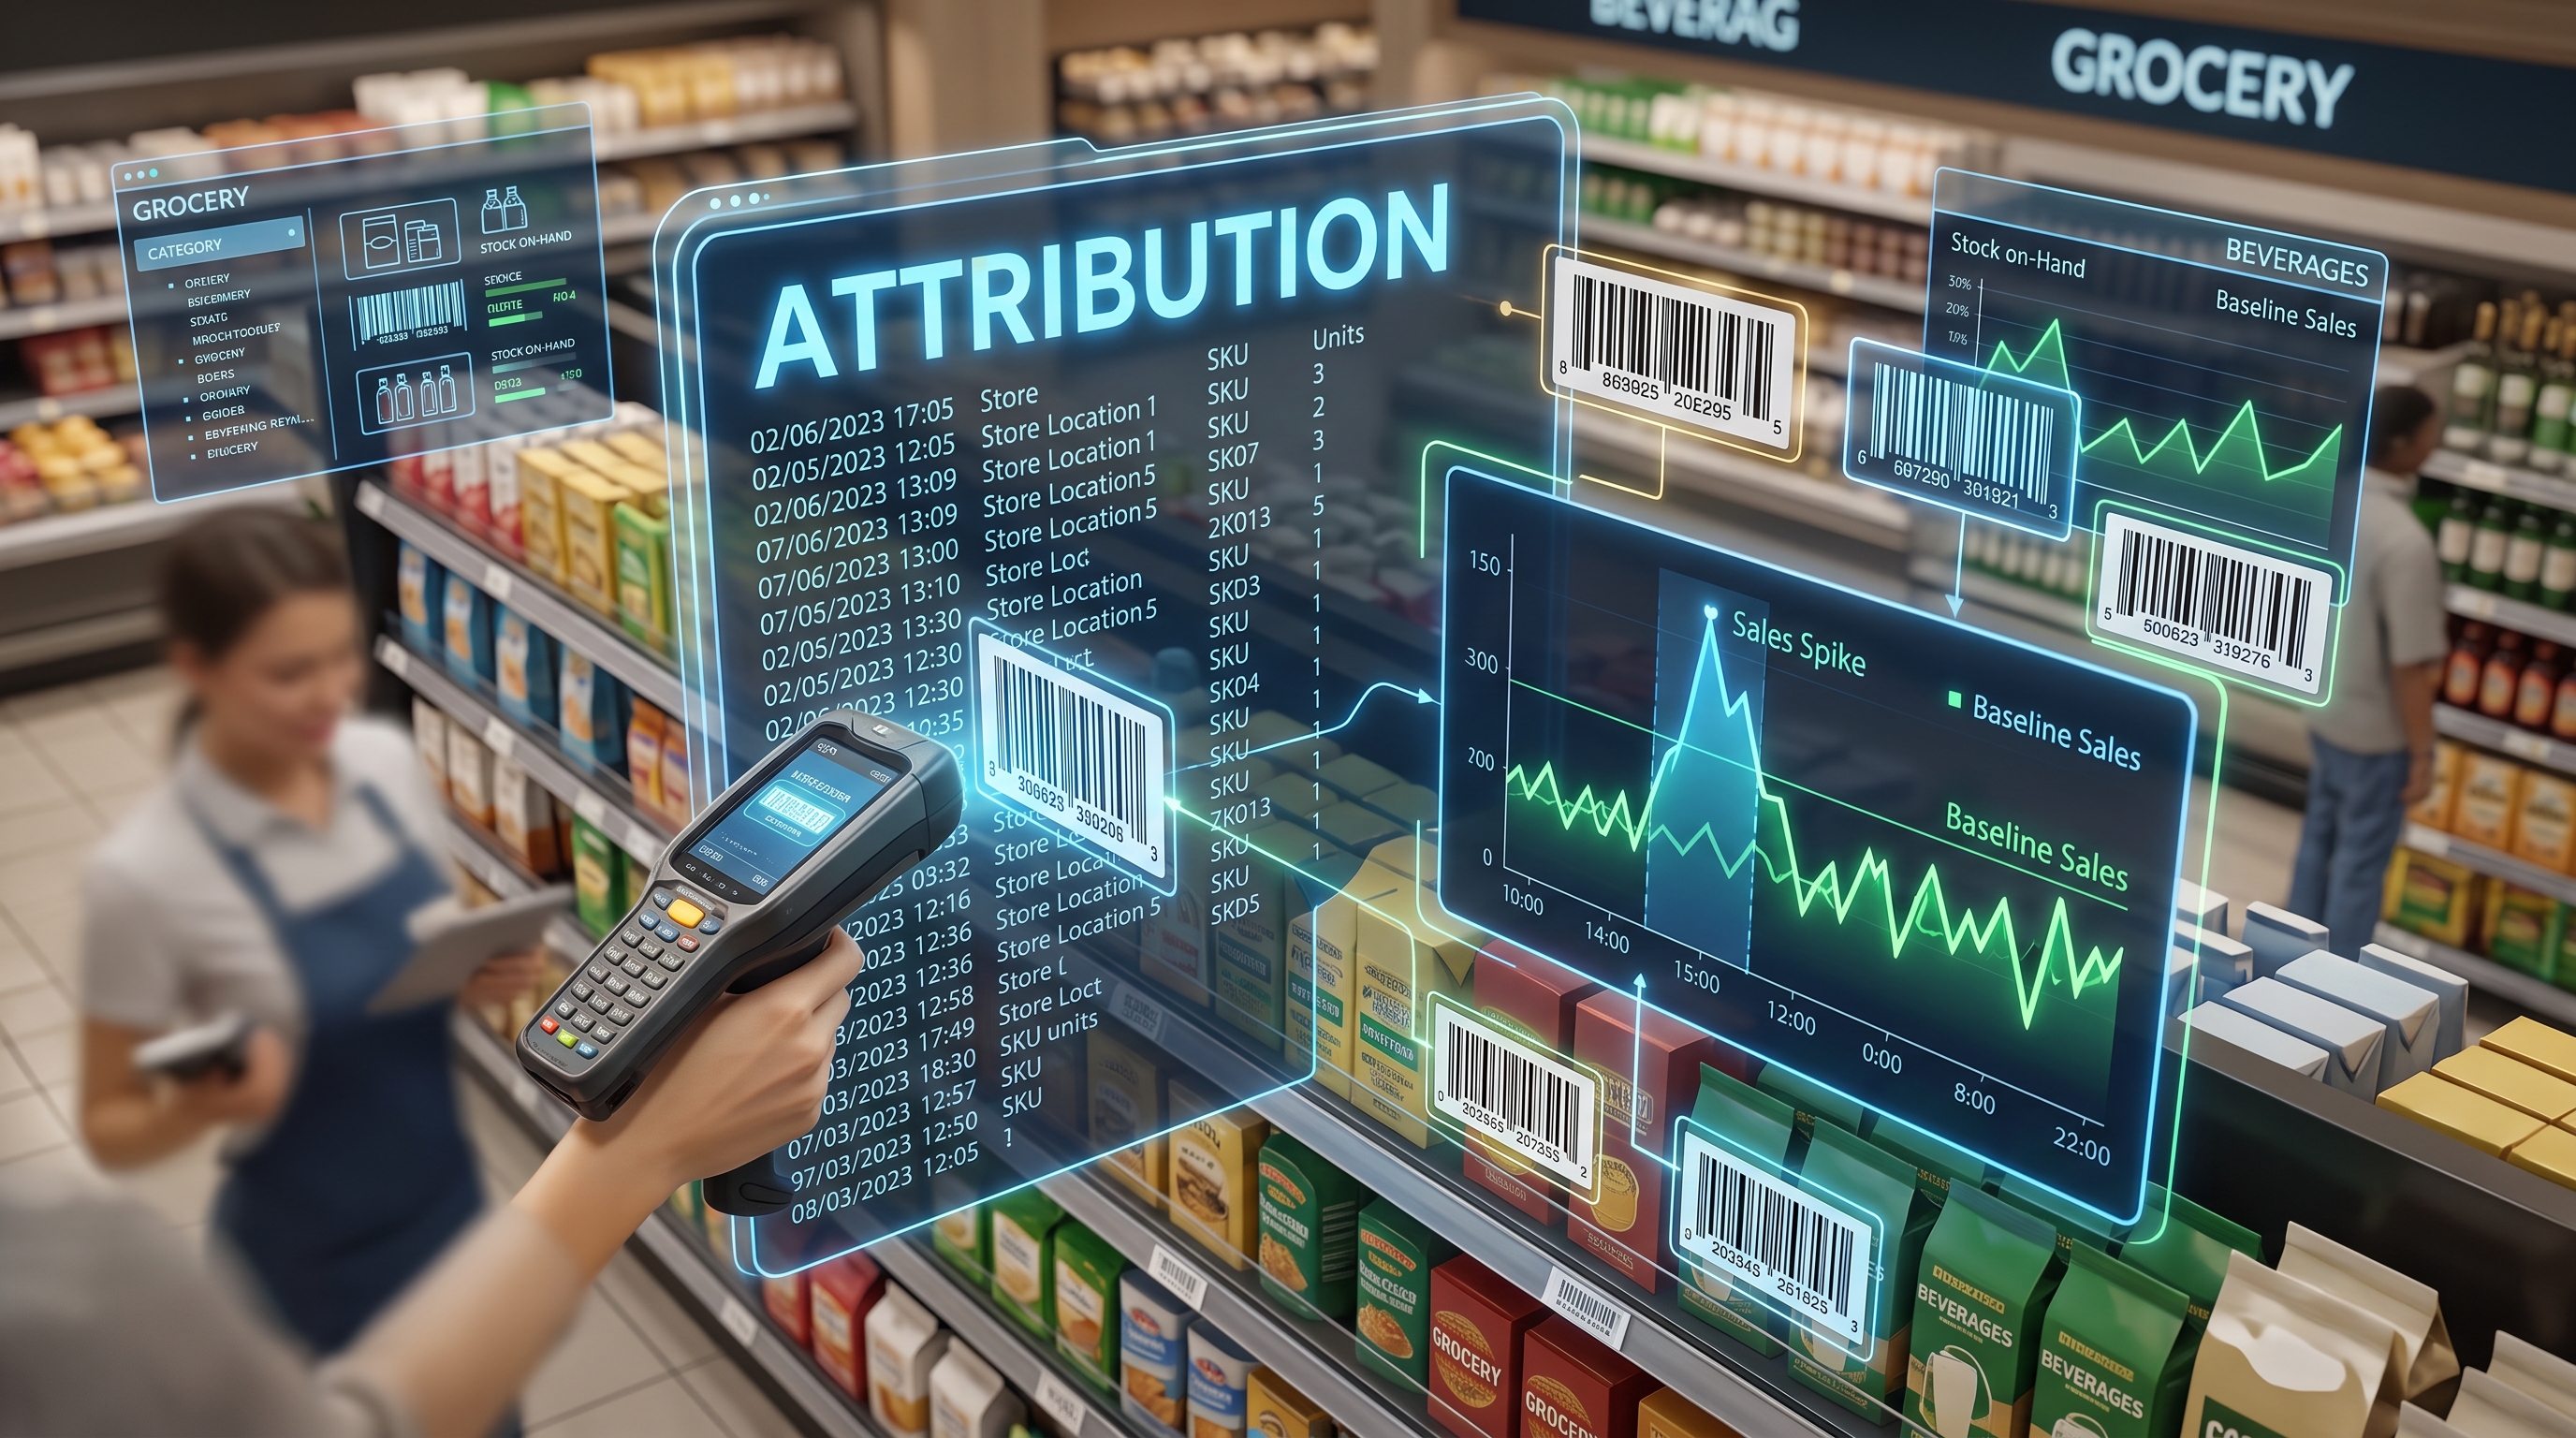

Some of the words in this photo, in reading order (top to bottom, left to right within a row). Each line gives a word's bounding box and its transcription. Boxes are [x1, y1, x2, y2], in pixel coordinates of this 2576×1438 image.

[2051, 27, 2355, 129] GROCERY
[133, 185, 249, 221] GROCERY
[148, 238, 222, 260] CATEGORY
[480, 238, 517, 254] STOCK
[519, 230, 572, 248] ON-HAND
[1951, 232, 2000, 260] Stock
[2005, 248, 2086, 279] on-Hand
[2226, 237, 2369, 287] BEVERAGES
[754, 182, 1450, 389] ATTRIBUTION
[1948, 274, 1972, 290] 30%
[1946, 301, 1969, 317] 20%
[2217, 288, 2298, 326] Baseline
[2305, 308, 2357, 339] Sales
[491, 346, 524, 361] STOCK
[525, 338, 575, 355] ON-HAND
[1313, 325, 1365, 350] Units
[1208, 342, 1249, 371] SKU
[1313, 362, 1325, 385] 3
[980, 386, 1038, 413] Store
[1208, 376, 1249, 405] SKU
[1313, 396, 1325, 418] 2
[1559, 360, 1567, 374] 8
[1773, 420, 1782, 434] 5
[751, 409, 885, 454] 02/06/2023
[894, 397, 954, 428] 17:05
[982, 421, 1040, 448] Store
[1047, 403, 1140, 435] Location
[1148, 394, 1155, 417] 1
[1208, 410, 1249, 439] SKU
[983, 456, 1041, 483] Store
[1048, 436, 1140, 471] Location
[1147, 430, 1154, 451] 1
[1313, 430, 1325, 450] 3
[753, 446, 886, 491] 02/05/2023
[896, 433, 955, 463] 12:05
[1313, 462, 1321, 483] 1
[754, 481, 887, 527] 02/06/2023
[897, 468, 957, 499] 13:09
[984, 491, 1041, 518] Store
[1049, 471, 1141, 506] Location
[1144, 463, 1156, 486] 5
[1208, 477, 1249, 506] SKU
[1857, 449, 1866, 465] 6
[2048, 504, 2057, 520] 3
[1313, 494, 1325, 516] 5
[756, 518, 888, 564] 07/06/2023
[898, 503, 958, 535] 13:09
[985, 525, 1042, 552] Store
[1049, 506, 1141, 539] Location
[1145, 497, 1157, 520] 5
[1313, 527, 1321, 549] 1
[758, 553, 890, 599] 07/06/2023
[900, 538, 959, 569] 13:00
[986, 560, 1043, 587] Store
[1208, 542, 1249, 572] SKU
[1313, 560, 1321, 580] 1
[1470, 549, 1500, 577] 150
[760, 588, 891, 636] 07/05/2023
[901, 573, 960, 605] 13:10
[987, 594, 1044, 621] Store
[1051, 572, 1143, 607] Location
[1313, 593, 1320, 612] 1
[1052, 606, 1142, 640] Location
[1146, 598, 1157, 619] 5
[1209, 609, 1249, 638] SKU
[1313, 625, 1320, 644] 1
[762, 623, 893, 671] 02/05/2023
[902, 608, 961, 639] 13:30
[1209, 642, 1249, 670] SKU
[1733, 610, 1793, 653] Sales
[1800, 632, 1867, 678] Spike
[2104, 607, 2112, 621] 5
[2144, 619, 2199, 647] 500623
[2305, 668, 2313, 682] 3
[764, 657, 894, 707] 02/05/2023
[904, 642, 962, 674] 12:30
[1313, 657, 1320, 676] 1
[1465, 647, 1499, 675] 300
[905, 676, 963, 709] 12:30
[1313, 689, 1320, 708] 1
[1209, 706, 1249, 736] SKU
[1313, 721, 1320, 739] 1
[1972, 694, 2071, 749] Baseline
[2078, 728, 2142, 771] Sales
[1209, 739, 1249, 768] SKU
[1313, 751, 1320, 769] 1
[1468, 746, 1495, 771] 200
[1210, 770, 1249, 800] SKU
[1313, 782, 1320, 800] 1
[989, 760, 996, 776] 3
[1150, 845, 1158, 862] 3
[1313, 813, 1320, 829] 1
[994, 837, 1049, 866] Store
[1210, 833, 1249, 862] SKU
[1313, 843, 1320, 860] 1
[1483, 848, 1492, 867] 0
[1946, 801, 2053, 865] Baseline
[2059, 843, 2129, 892] Sales
[995, 869, 1050, 898] Store
[1211, 865, 1249, 894] SKU
[914, 888, 971, 923] 12:16
[996, 899, 1050, 931] Store
[1058, 873, 1144, 912] Location
[1211, 894, 1260, 925] SKD5
[1502, 884, 1544, 916] 10:00
[915, 921, 972, 955] 12:36
[997, 931, 1051, 962] Store
[1059, 905, 1144, 945] Location
[1149, 896, 1161, 917] 5
[1585, 921, 1630, 954] 14:00
[916, 953, 973, 988] 12:36
[998, 964, 1052, 994] Store
[1674, 960, 1720, 994] 15:00
[917, 985, 974, 1020] 12:58
[999, 996, 1052, 1026] Store
[1060, 976, 1102, 1007] Loct
[919, 1018, 974, 1051] 17:49
[1000, 1026, 1041, 1057] SKU
[1047, 1011, 1098, 1041] units
[1767, 1000, 1816, 1036] 12:00
[920, 1049, 975, 1083] 18:30
[1001, 1056, 1041, 1088] SKU
[1862, 1042, 1902, 1075] 0:00
[1003, 1086, 1042, 1118] SKU
[1954, 1082, 1996, 1115] 8:00
[787, 1103, 910, 1160] 07/03/2023
[921, 1079, 976, 1114] 12:57
[791, 1135, 911, 1192] 97/03/2023
[922, 1111, 978, 1146] 12:50
[2053, 1125, 2111, 1167] 22:00
[792, 1167, 912, 1225] 08/03/2023
[924, 1141, 979, 1178] 12:05
[1580, 1166, 1588, 1179] 2
[1851, 1320, 1858, 1333] 3
[1917, 1283, 2013, 1348] BEVERAGES
[1433, 1326, 1502, 1387] GROCERY
[2042, 1349, 2144, 1419] BEVERAGES
